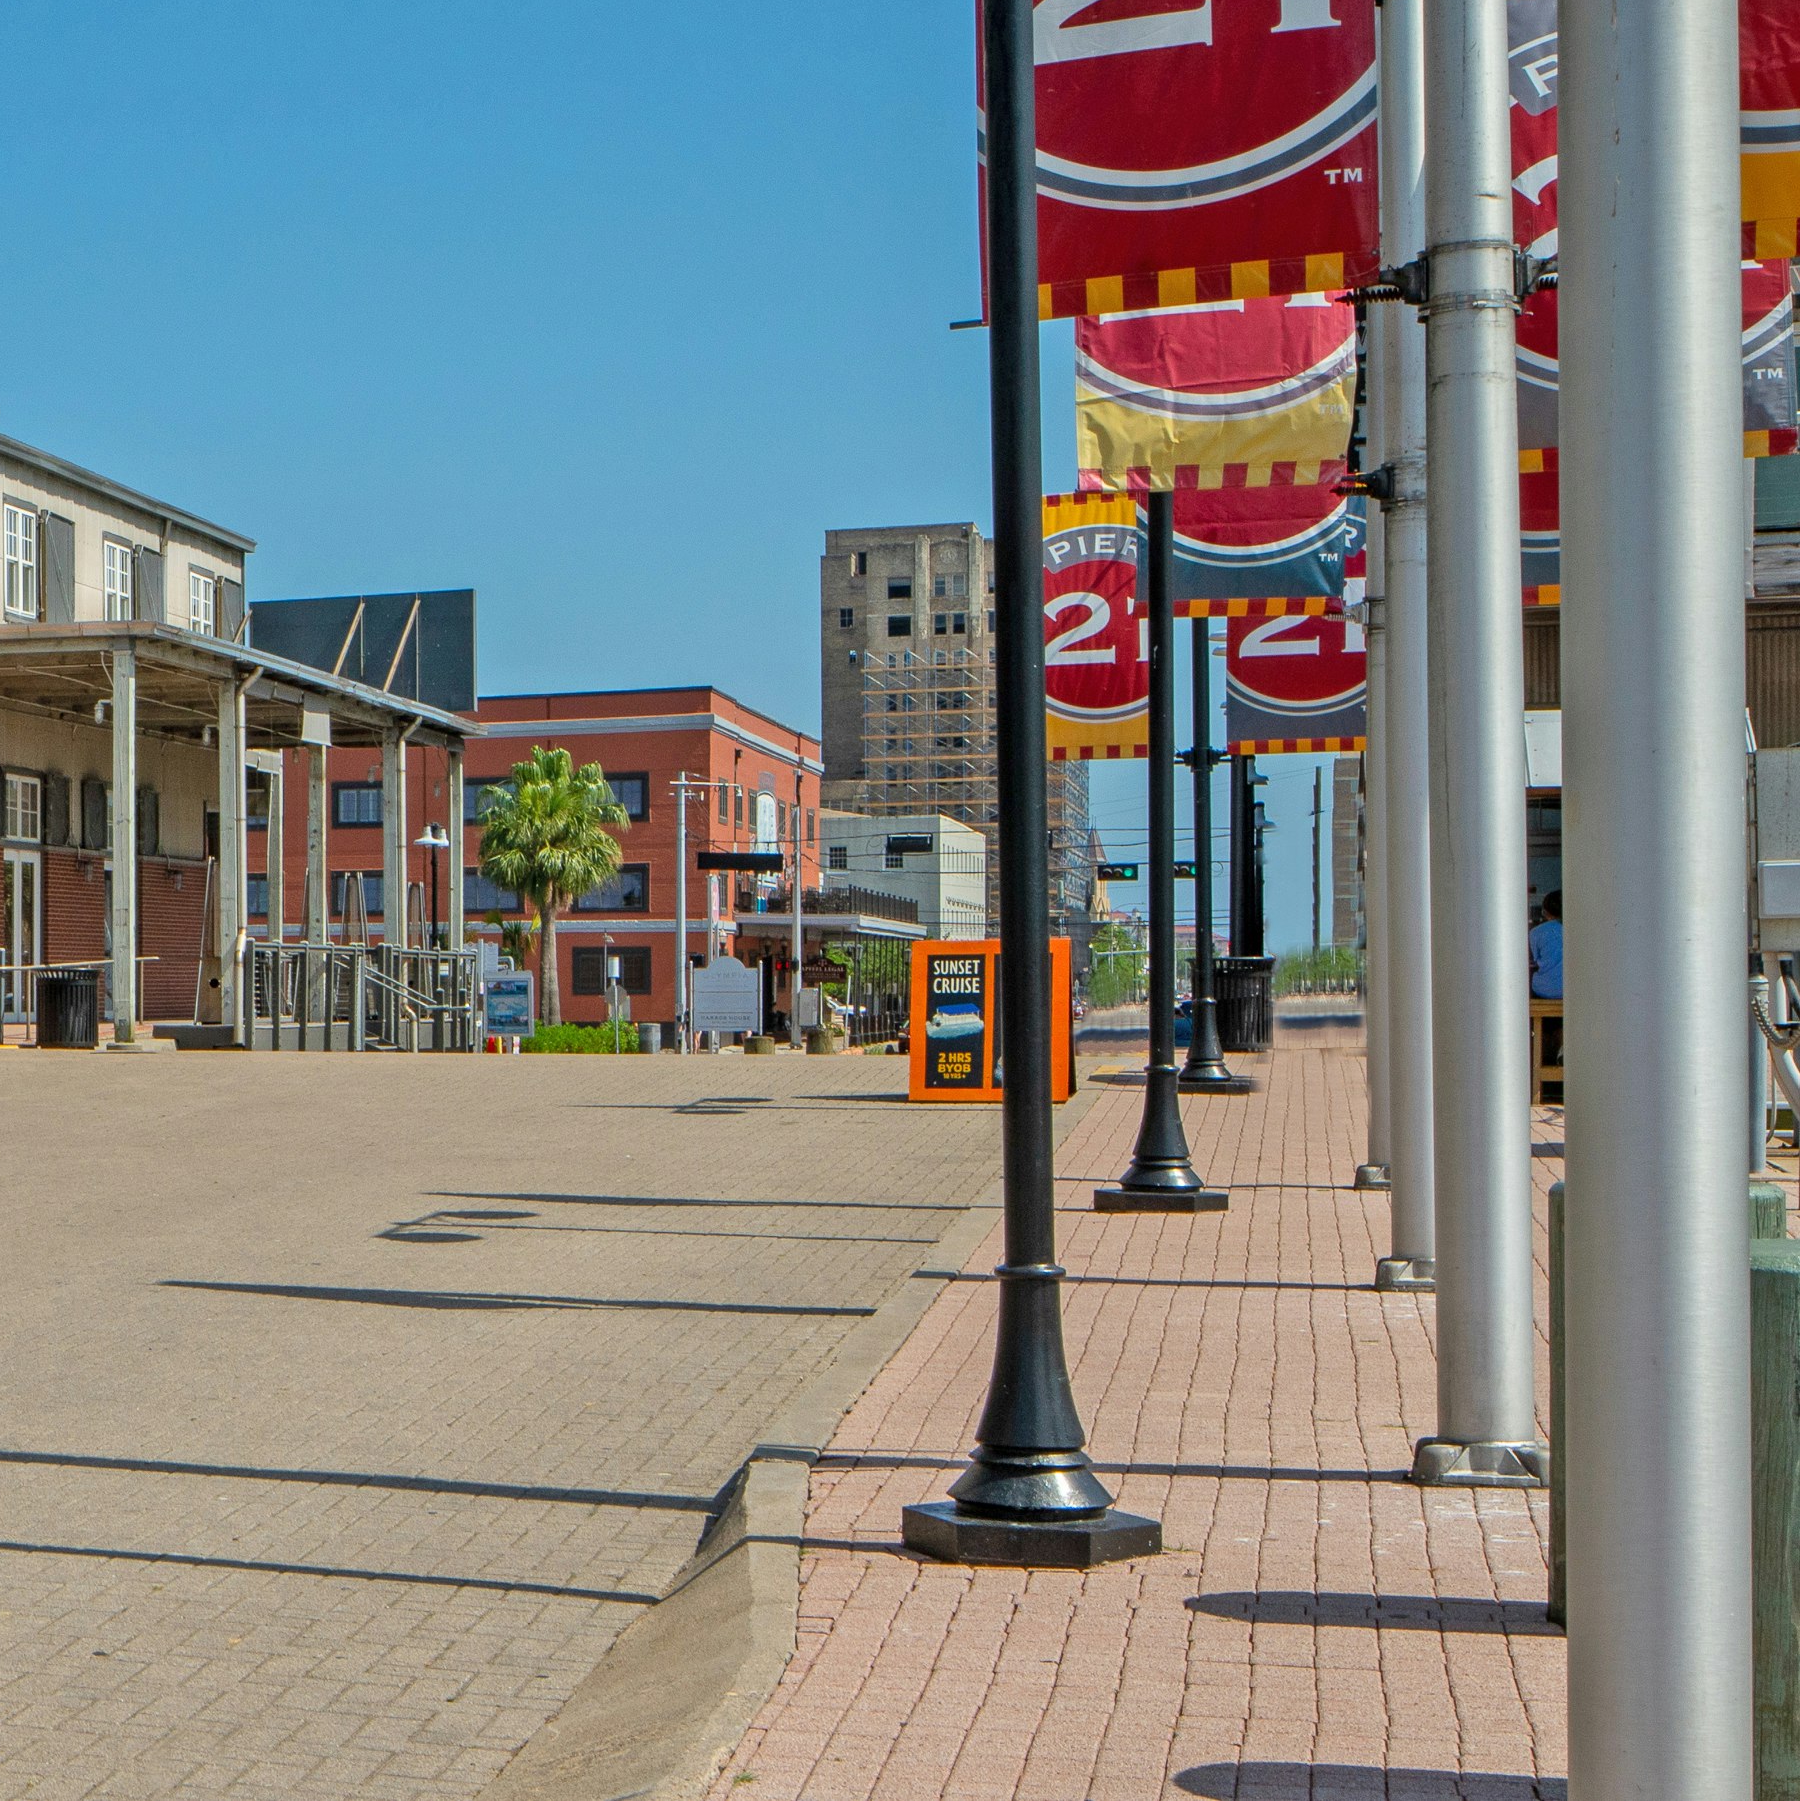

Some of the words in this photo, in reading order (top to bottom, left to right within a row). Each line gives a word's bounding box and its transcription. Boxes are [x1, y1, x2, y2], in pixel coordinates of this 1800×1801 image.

[1323, 167, 1363, 185] TM
[1752, 367, 1783, 380] TM
[1318, 552, 1339, 562] TM
[933, 960, 981, 975] SUNSET
[933, 978, 980, 994] CRUISE
[938, 1052, 946, 1063] 2
[949, 1052, 972, 1063] HRS
[938, 1063, 972, 1073] BYOB
